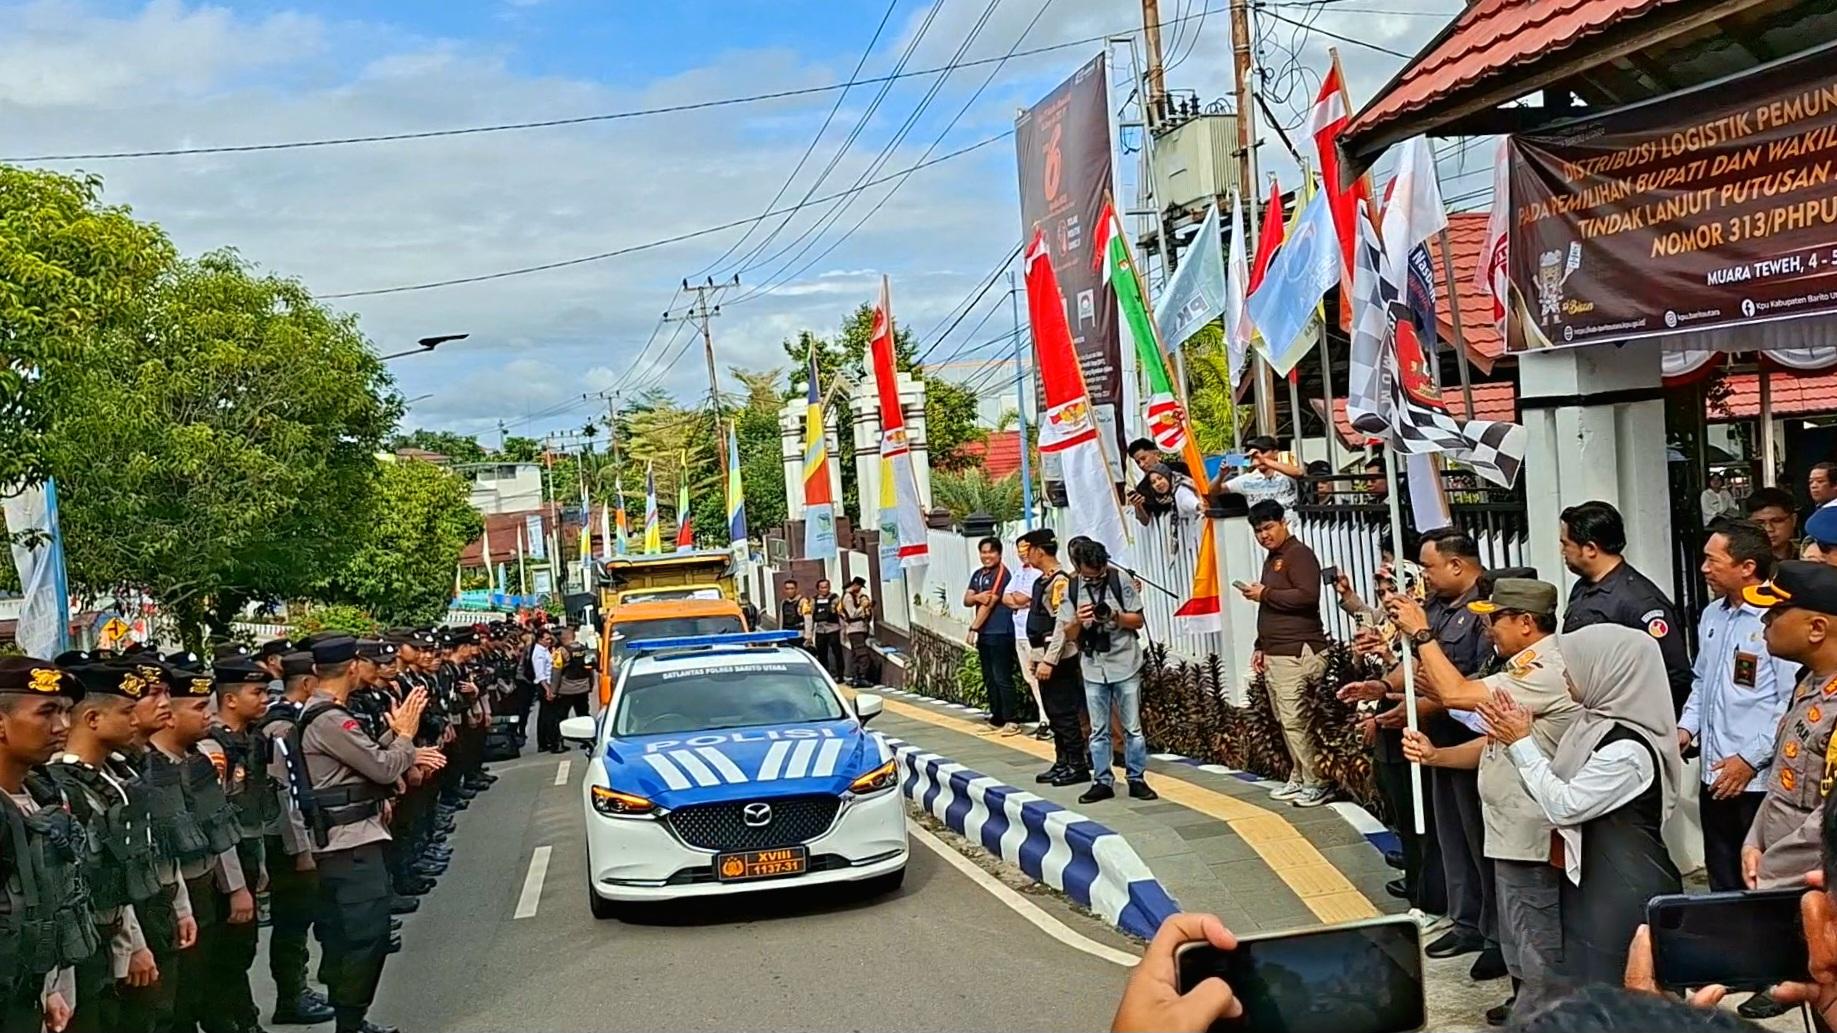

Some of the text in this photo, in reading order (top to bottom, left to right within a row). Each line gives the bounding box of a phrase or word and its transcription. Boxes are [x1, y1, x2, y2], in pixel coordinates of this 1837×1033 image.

[1563, 142, 1656, 183] DISTRIBUSI
[1661, 112, 1753, 160] LOGISTIK
[1517, 126, 1837, 228] PADA PEMILIHAN BUPATI DAN WAKIL
[1577, 161, 1832, 240] TINDAK LANJUT PUTUSAN
[1650, 223, 1724, 258] NOMOR
[1707, 266, 1751, 286] MUARA
[1753, 255, 1804, 278] TEWEH,
[1808, 253, 1818, 269] 4
[1756, 301, 1769, 311] Kpu
[1770, 295, 1807, 309] Kabupaten
[1807, 293, 1829, 303] Barito
[662, 664, 787, 680] SATLANTAS POLRES BARITO UTARA
[647, 728, 835, 753] POLISI
[753, 861, 799, 875] 1137-31
[758, 850, 792, 862] XVIII
